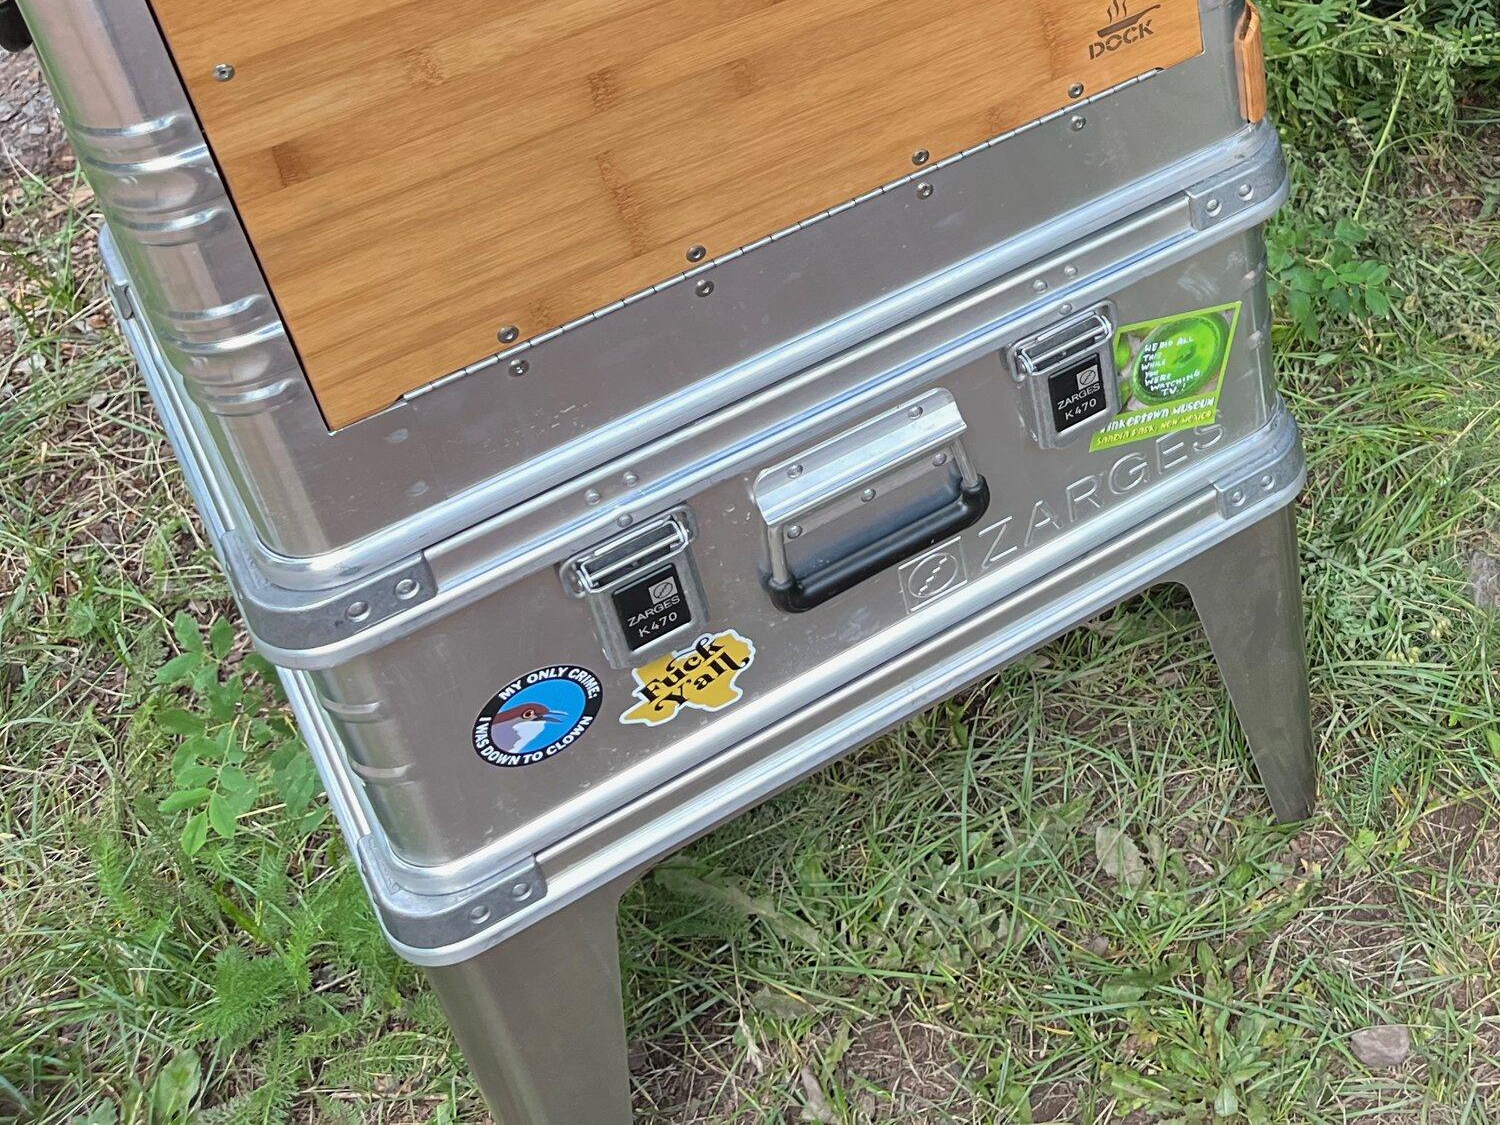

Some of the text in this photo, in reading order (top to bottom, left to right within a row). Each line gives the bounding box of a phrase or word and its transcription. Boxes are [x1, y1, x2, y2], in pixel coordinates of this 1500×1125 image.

[1088, 19, 1154, 60] DOCK
[1150, 368, 1201, 391] WATCHING
[1057, 382, 1100, 410] ZARGES
[978, 411, 1225, 574] ZARGES
[627, 595, 681, 627] ZARGES
[499, 680, 522, 701] MY
[526, 667, 569, 684] ONLY
[639, 636, 725, 704] Fuck
[475, 722, 490, 749] WAS
[546, 715, 594, 756] CLOWN
[481, 745, 522, 766] DOWN
[523, 751, 545, 765] TO
